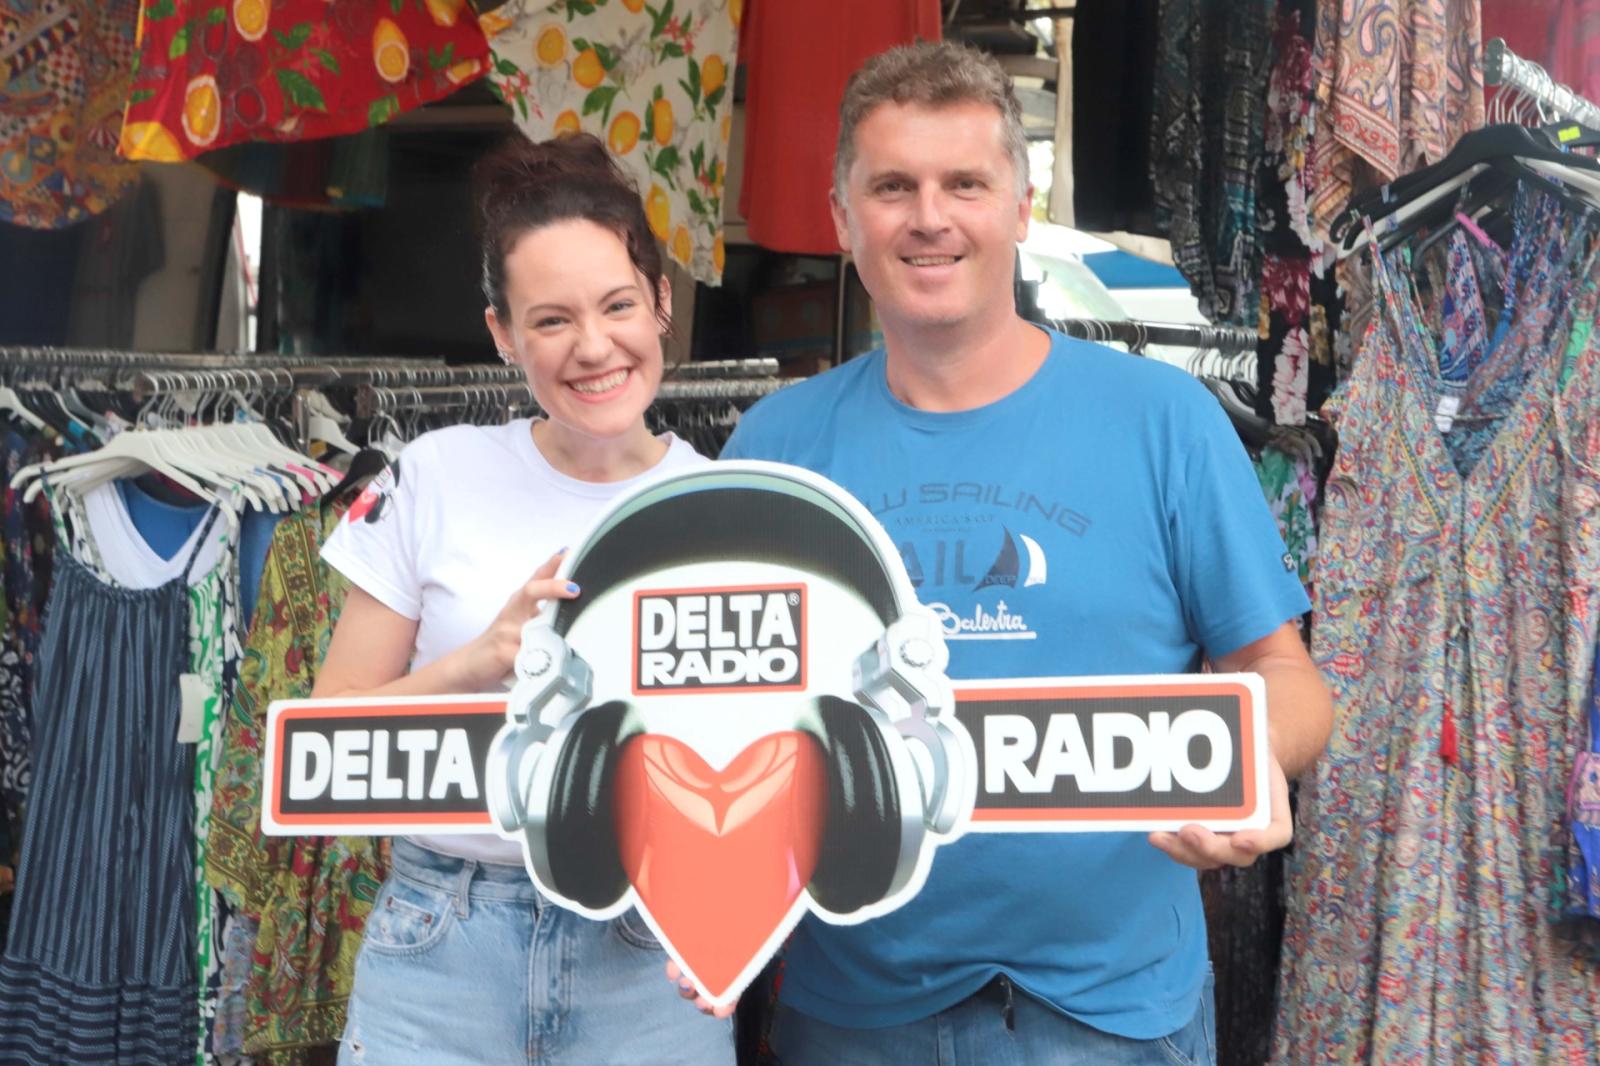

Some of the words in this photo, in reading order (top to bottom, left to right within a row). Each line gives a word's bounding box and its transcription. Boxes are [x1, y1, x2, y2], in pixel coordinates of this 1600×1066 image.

[920, 482, 1092, 537] SAILING
[641, 647, 798, 686] RADIO
[288, 728, 479, 801] DELTA
[984, 709, 1233, 793] RADIO
